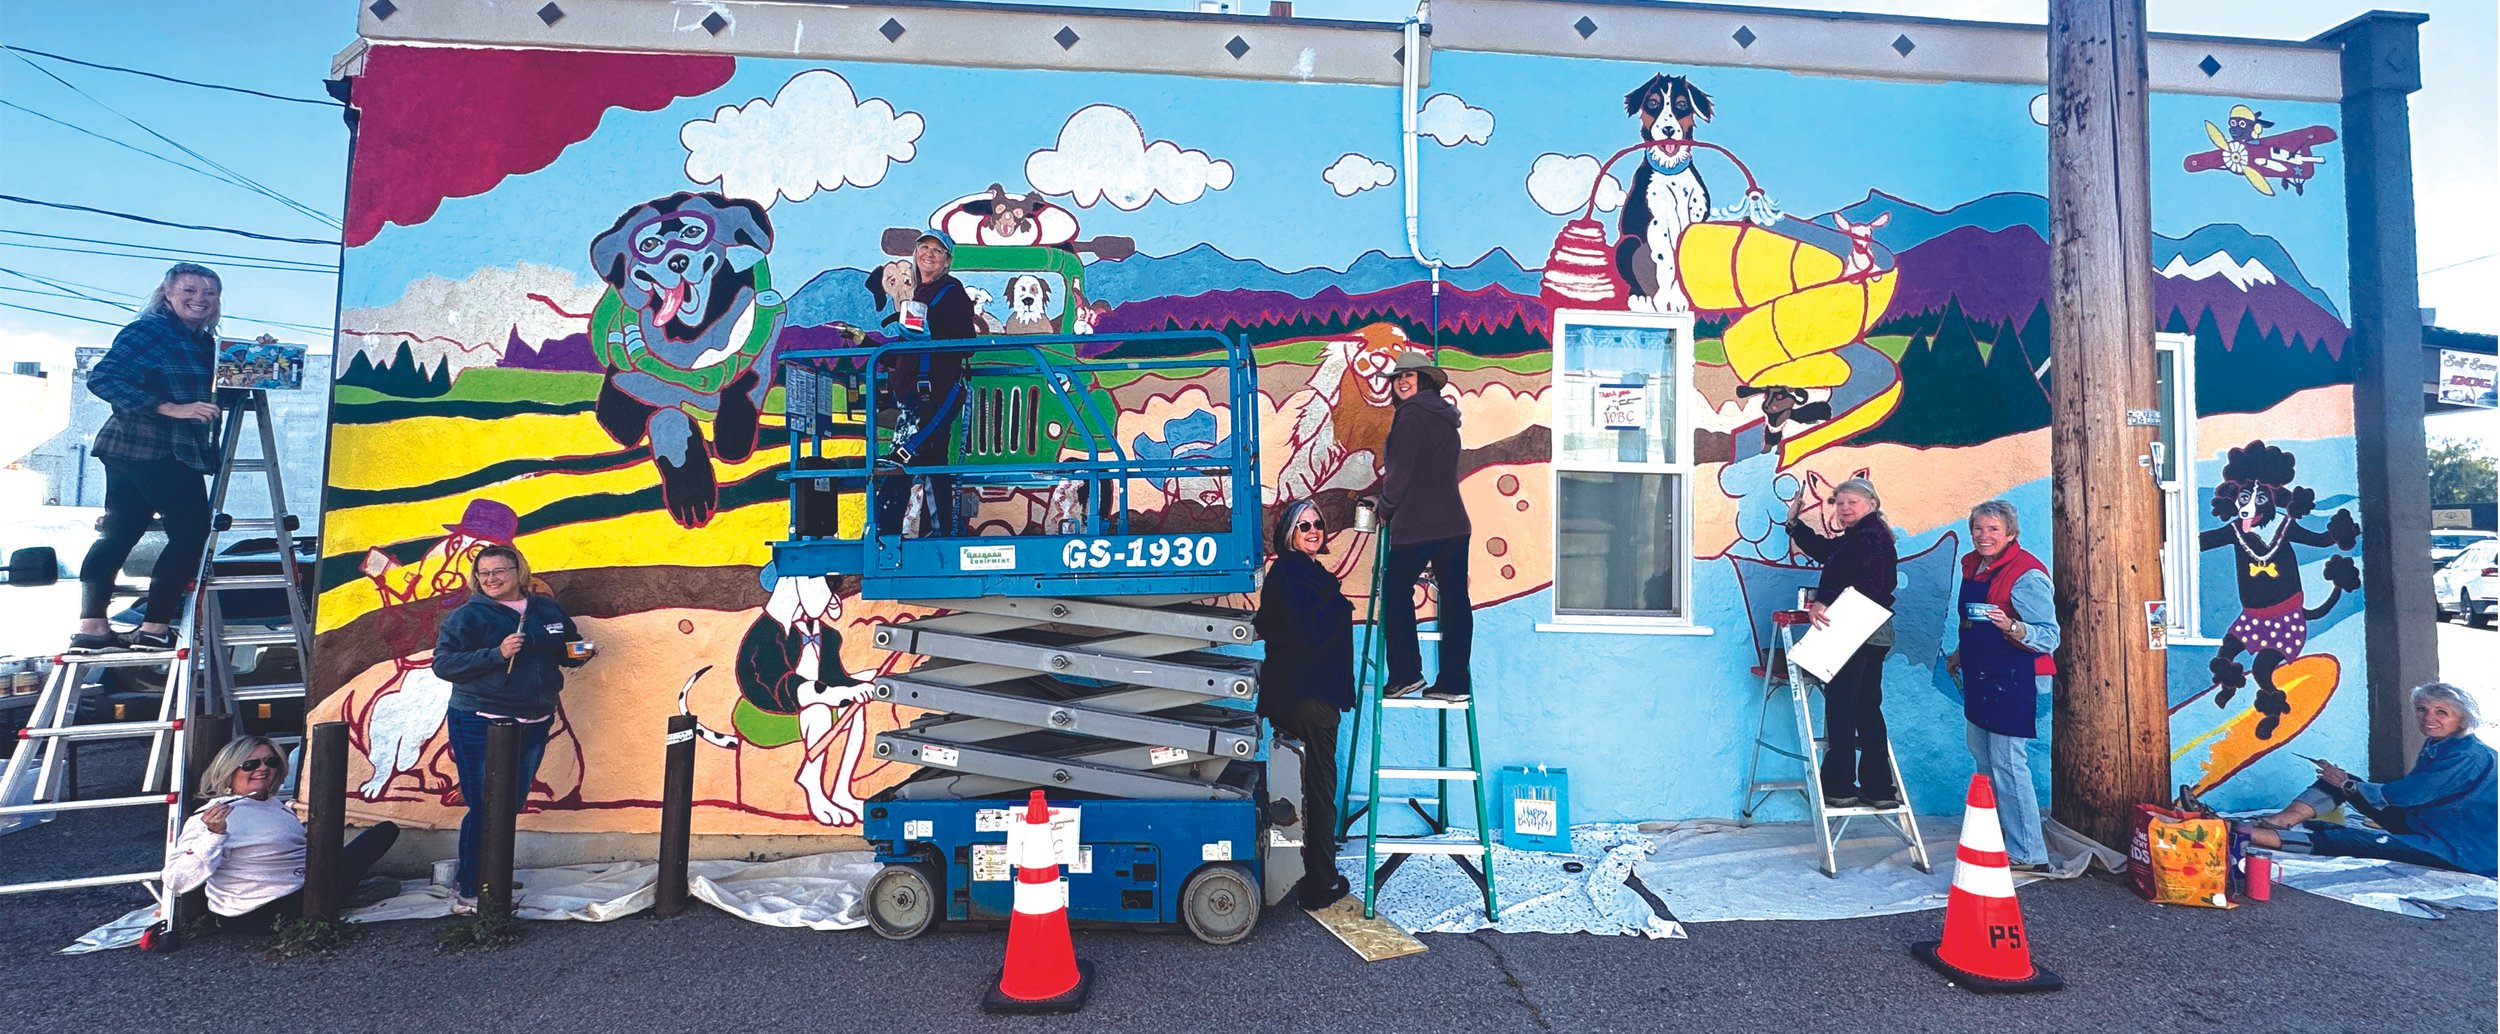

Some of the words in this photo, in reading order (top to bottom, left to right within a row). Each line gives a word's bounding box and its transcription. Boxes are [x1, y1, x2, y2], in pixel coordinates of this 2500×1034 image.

[1062, 536, 1218, 569] GS-1930
[1522, 806, 1548, 827] Happy
[1989, 925, 2021, 949] PS
